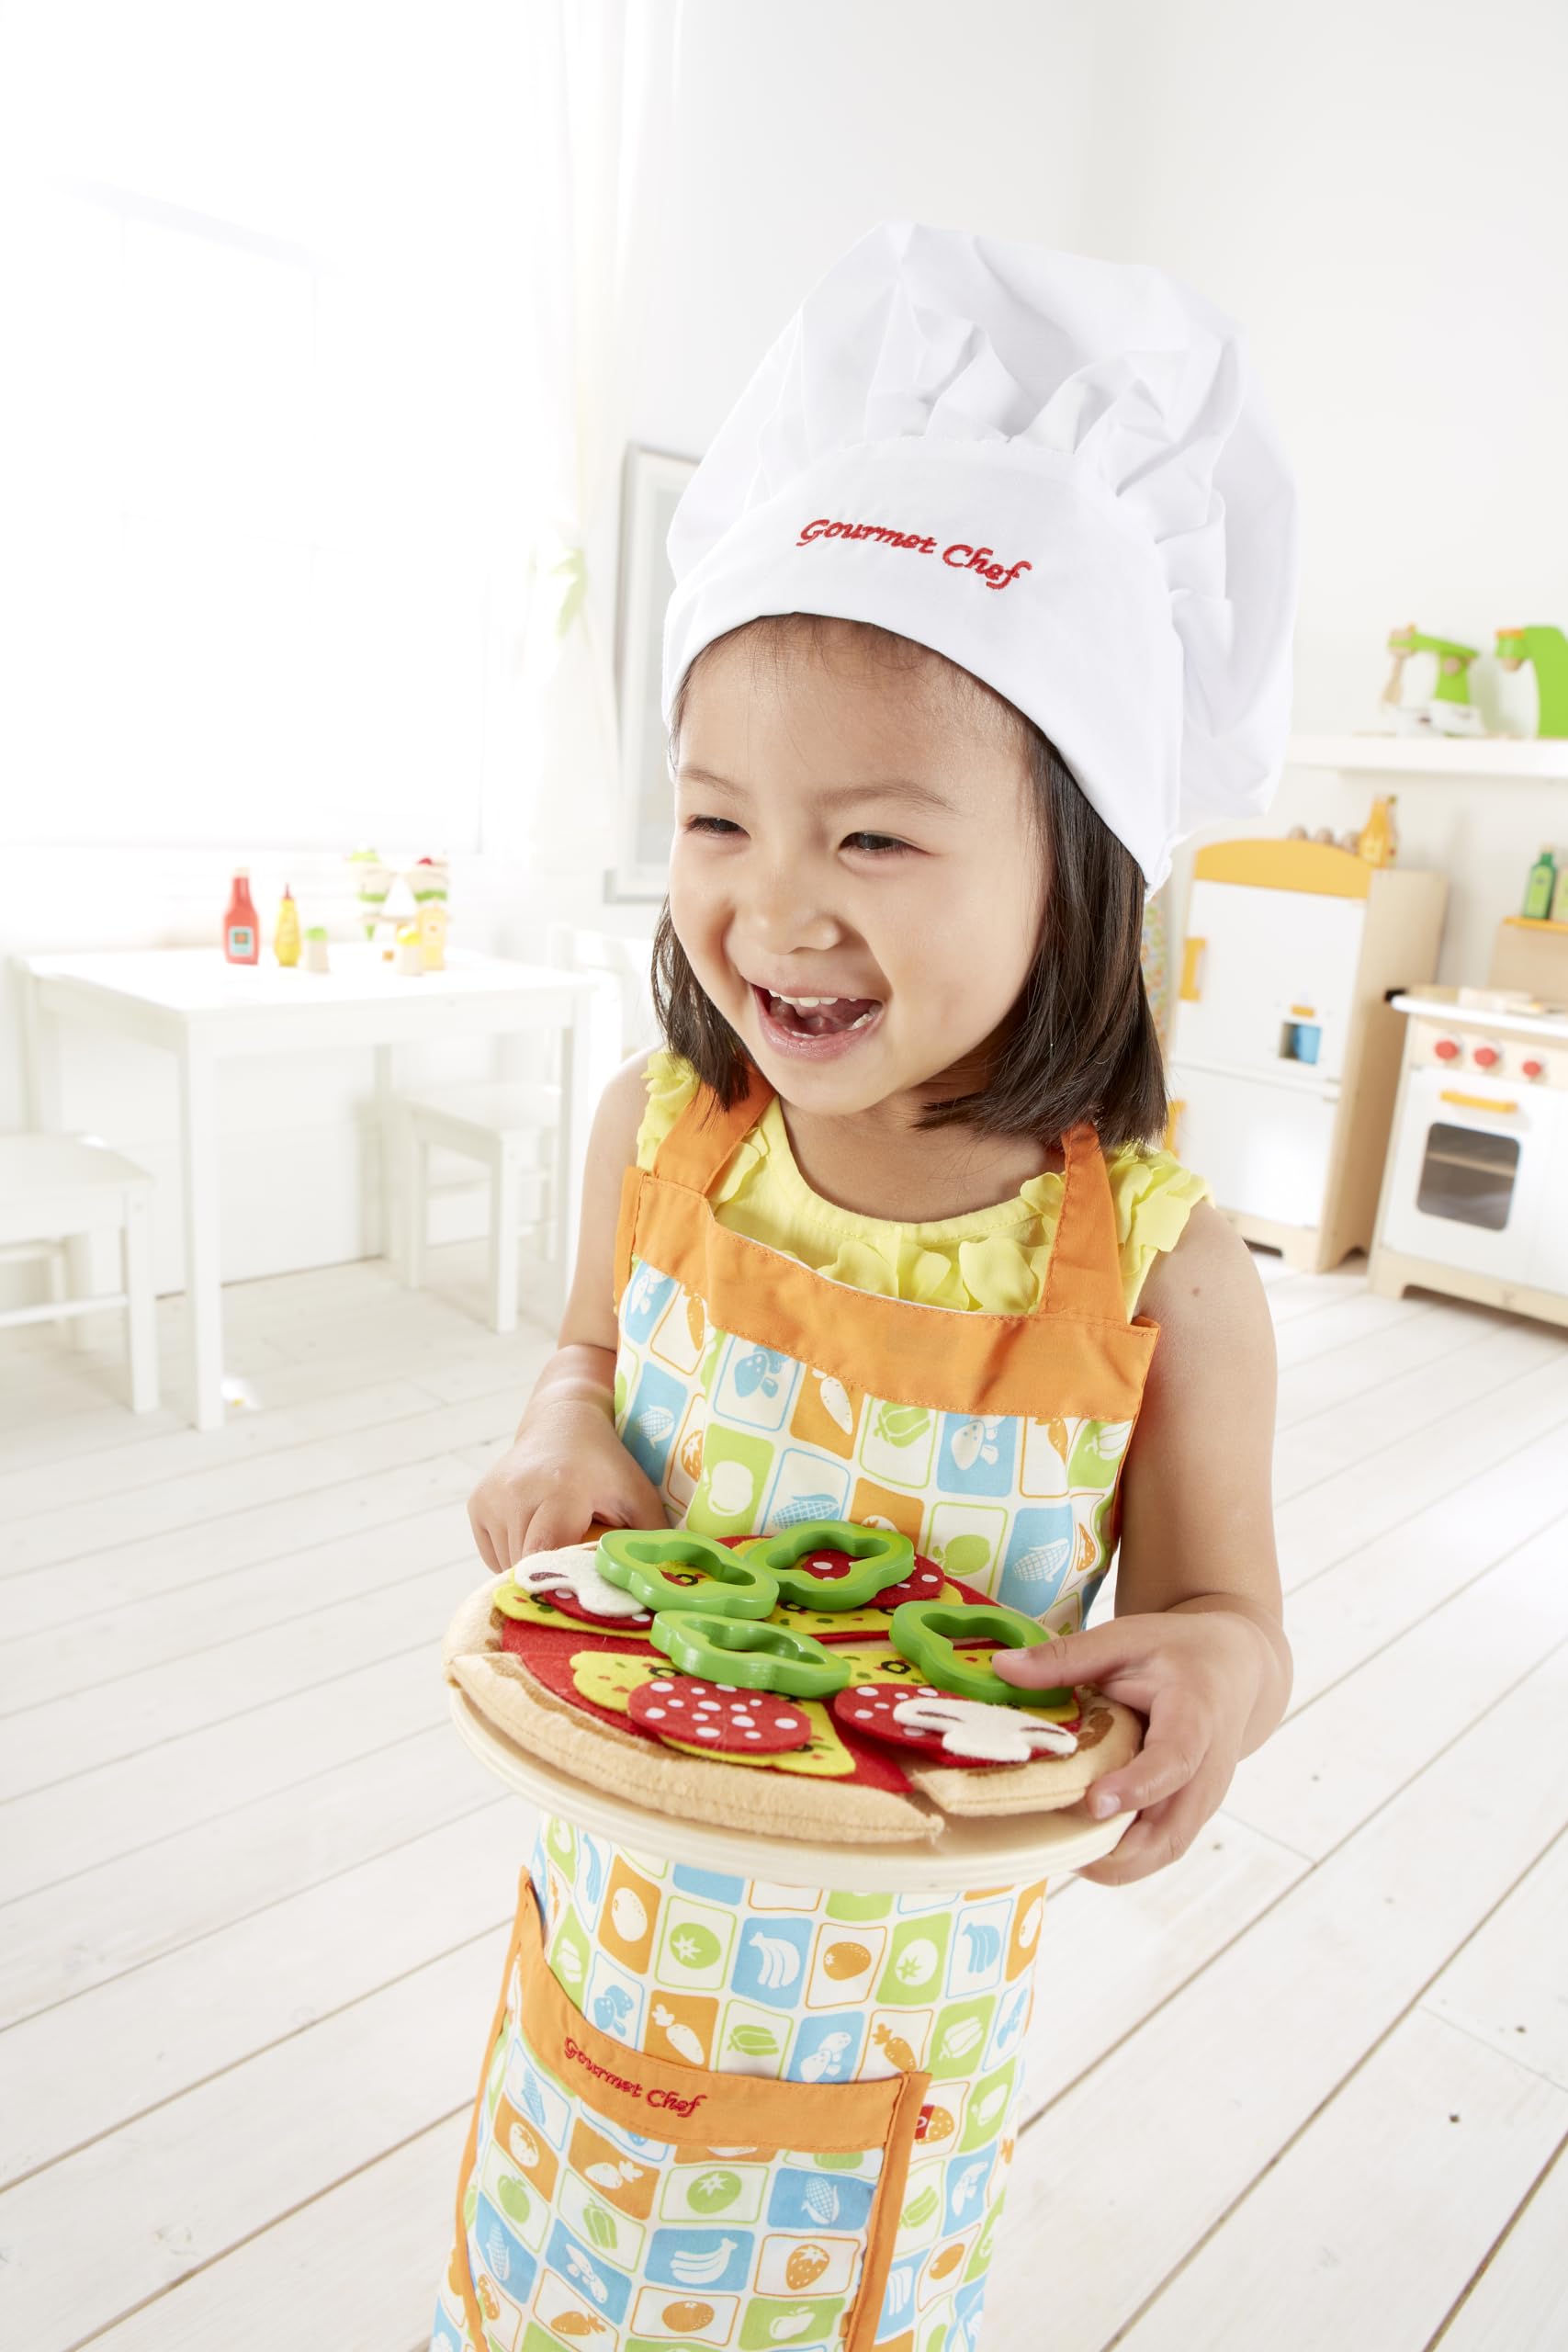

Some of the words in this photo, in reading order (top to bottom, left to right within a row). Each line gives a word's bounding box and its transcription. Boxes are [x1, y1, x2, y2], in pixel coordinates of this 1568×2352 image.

[795, 519, 937, 554] Gourmet
[942, 544, 1032, 590] Chef
[564, 2037, 642, 2098] Gourmet
[646, 2088, 707, 2118] Chef
